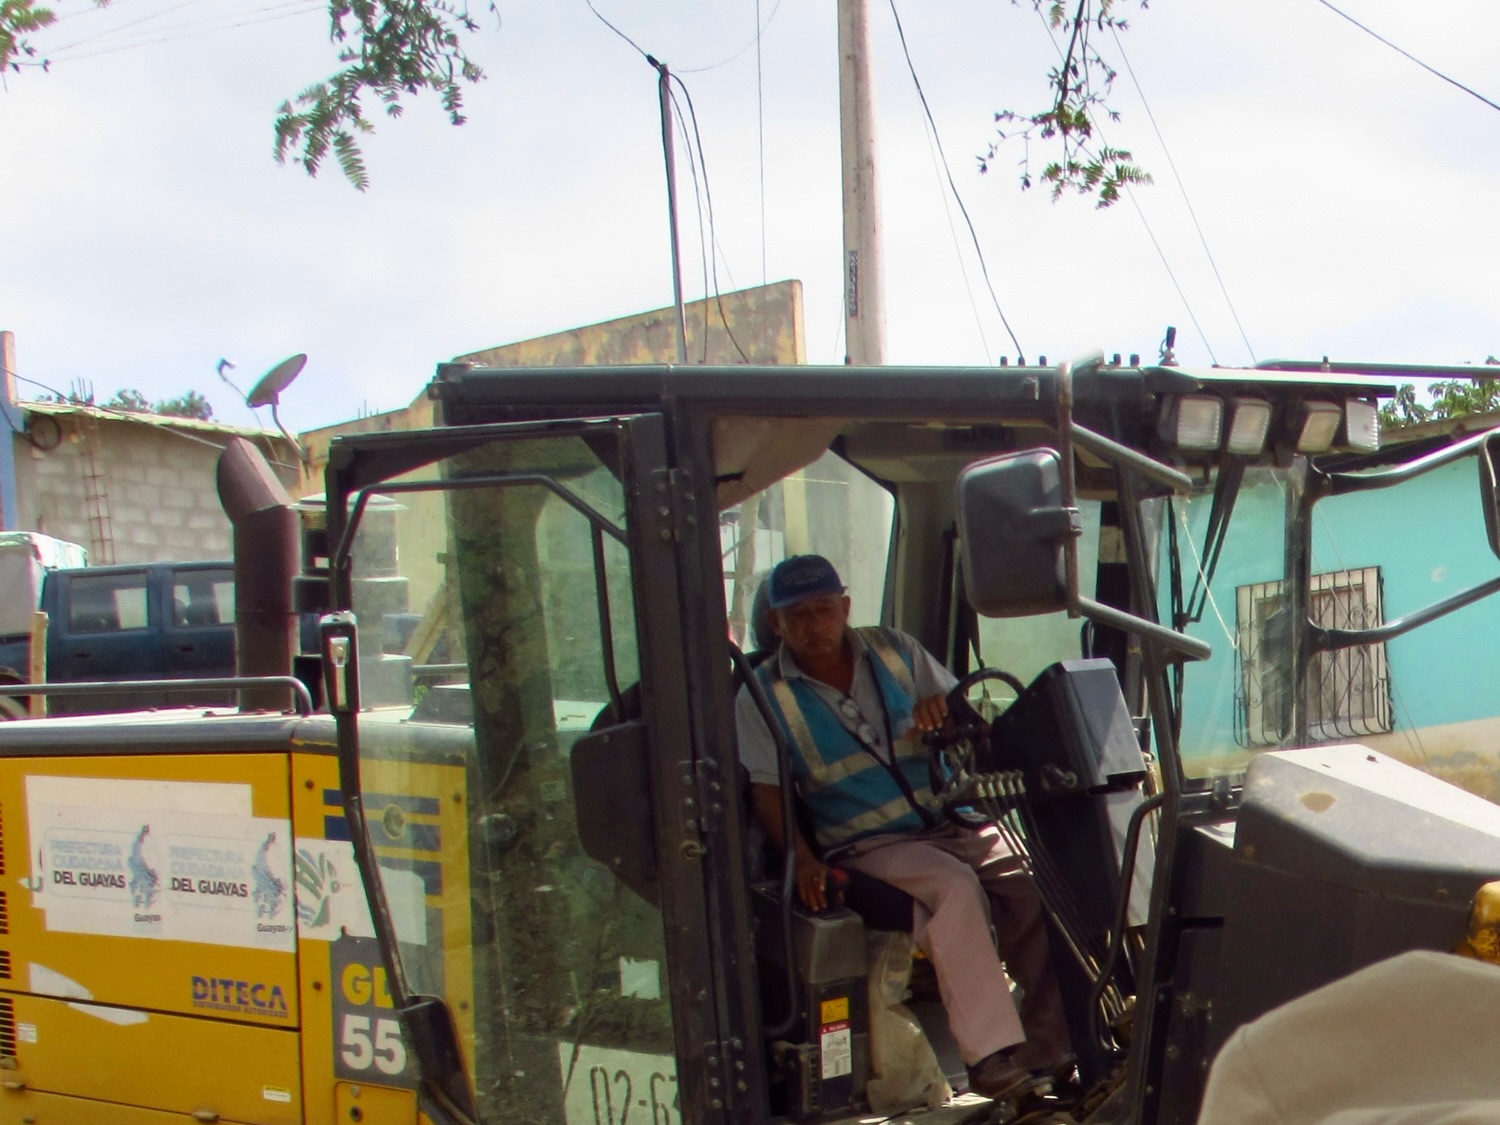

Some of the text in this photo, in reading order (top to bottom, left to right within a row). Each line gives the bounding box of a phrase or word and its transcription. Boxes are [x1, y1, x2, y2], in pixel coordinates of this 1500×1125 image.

[53, 870, 126, 889] DEL GUAYAS
[171, 876, 249, 898] DEL GUAYAS
[134, 913, 161, 924] Guayas
[257, 923, 287, 934] Guayas
[192, 975, 288, 1011] DITECA
